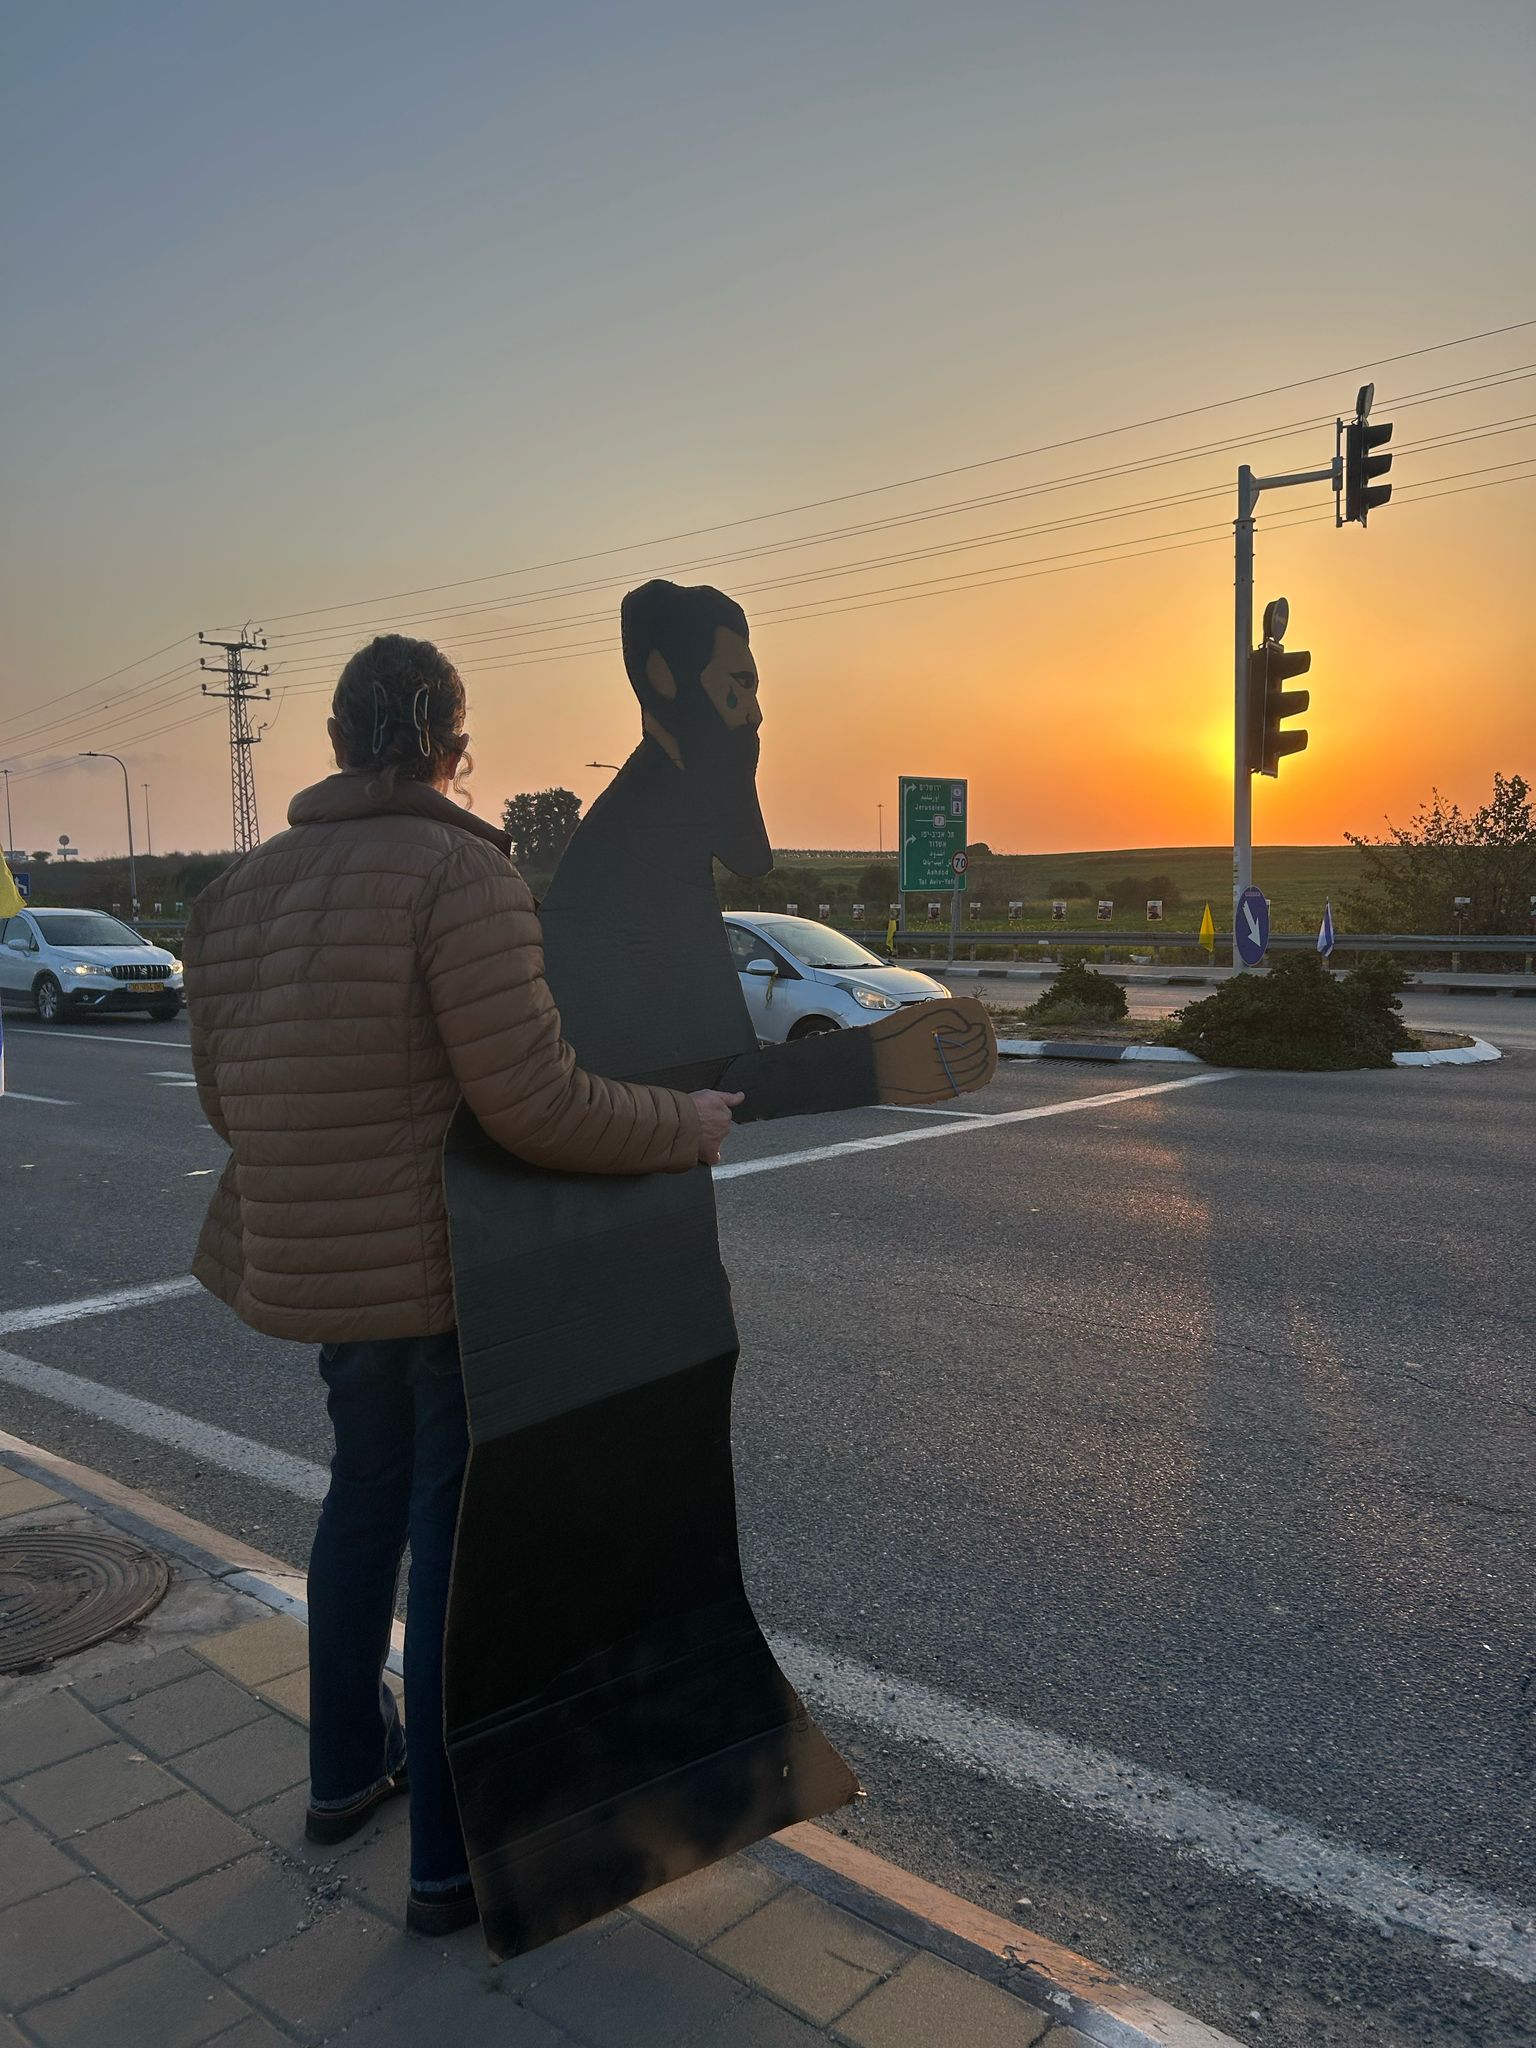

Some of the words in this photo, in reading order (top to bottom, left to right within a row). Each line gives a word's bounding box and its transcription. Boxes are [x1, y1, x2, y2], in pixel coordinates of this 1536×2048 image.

[915, 803, 946, 811] Jerusalem
[955, 858, 966, 868] 70
[929, 878, 957, 886] Aviv-Yaf
